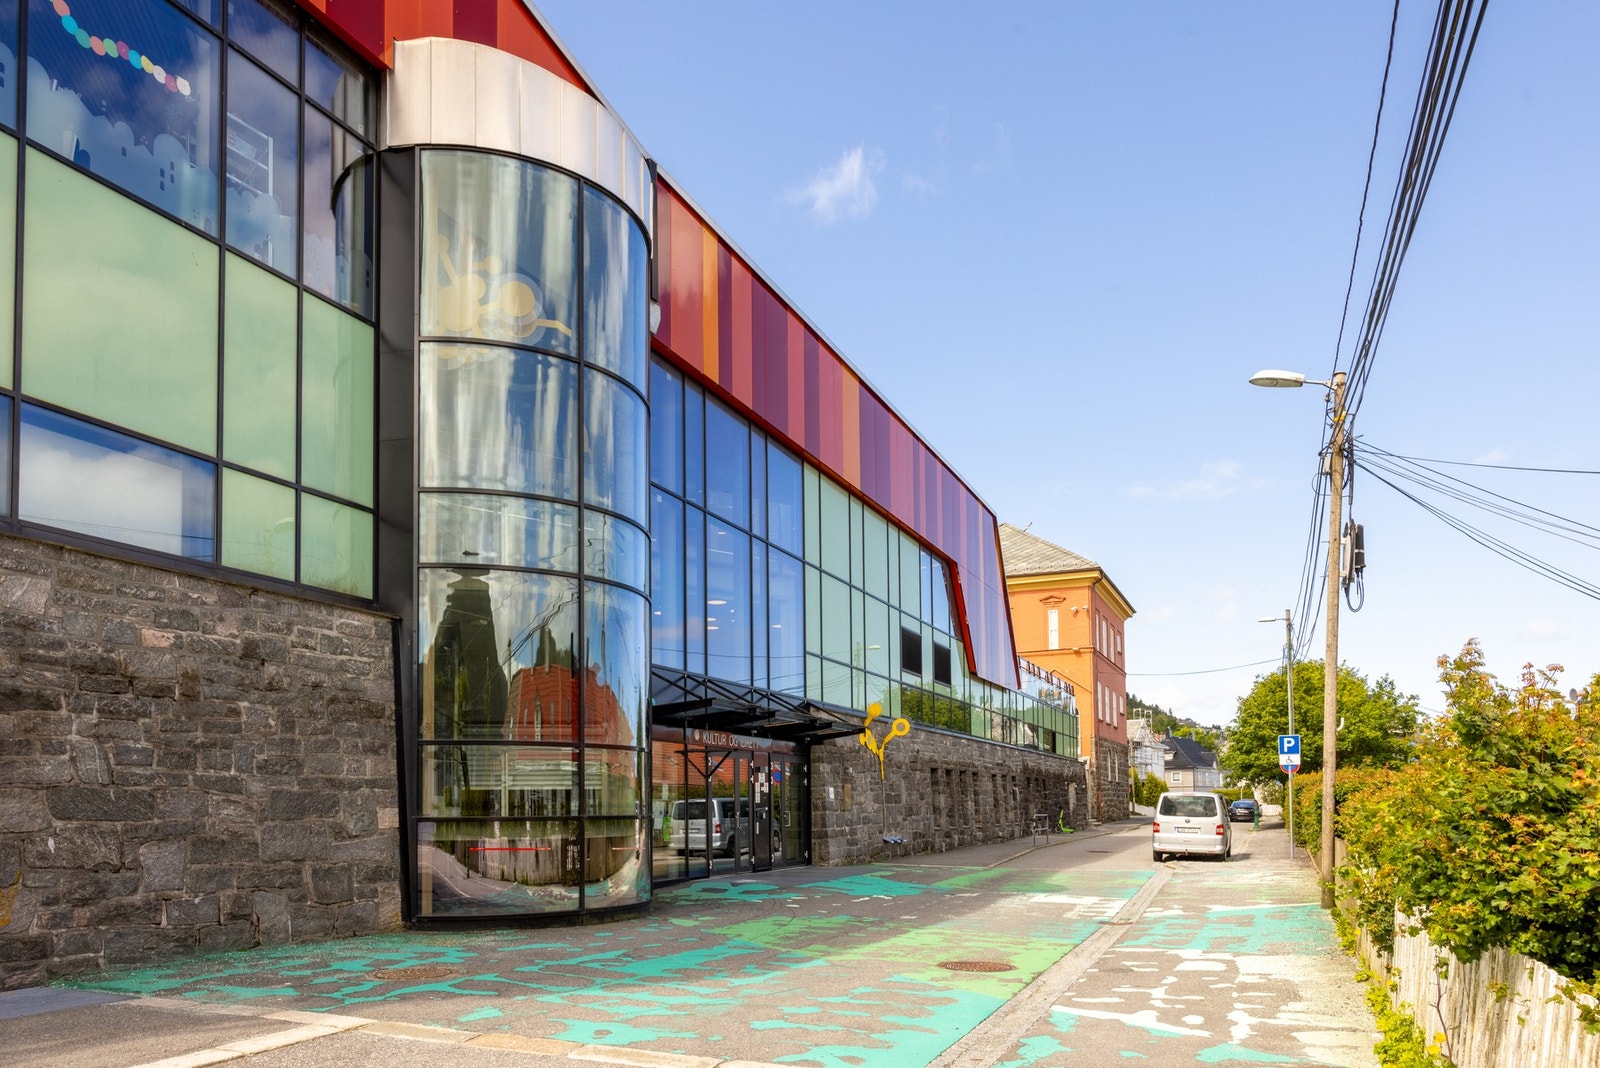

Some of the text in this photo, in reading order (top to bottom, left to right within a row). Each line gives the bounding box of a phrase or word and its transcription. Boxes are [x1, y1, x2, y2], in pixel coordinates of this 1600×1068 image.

[702, 731, 727, 745] KULTUR
[728, 734, 739, 747] OG
[1283, 737, 1295, 752] P
